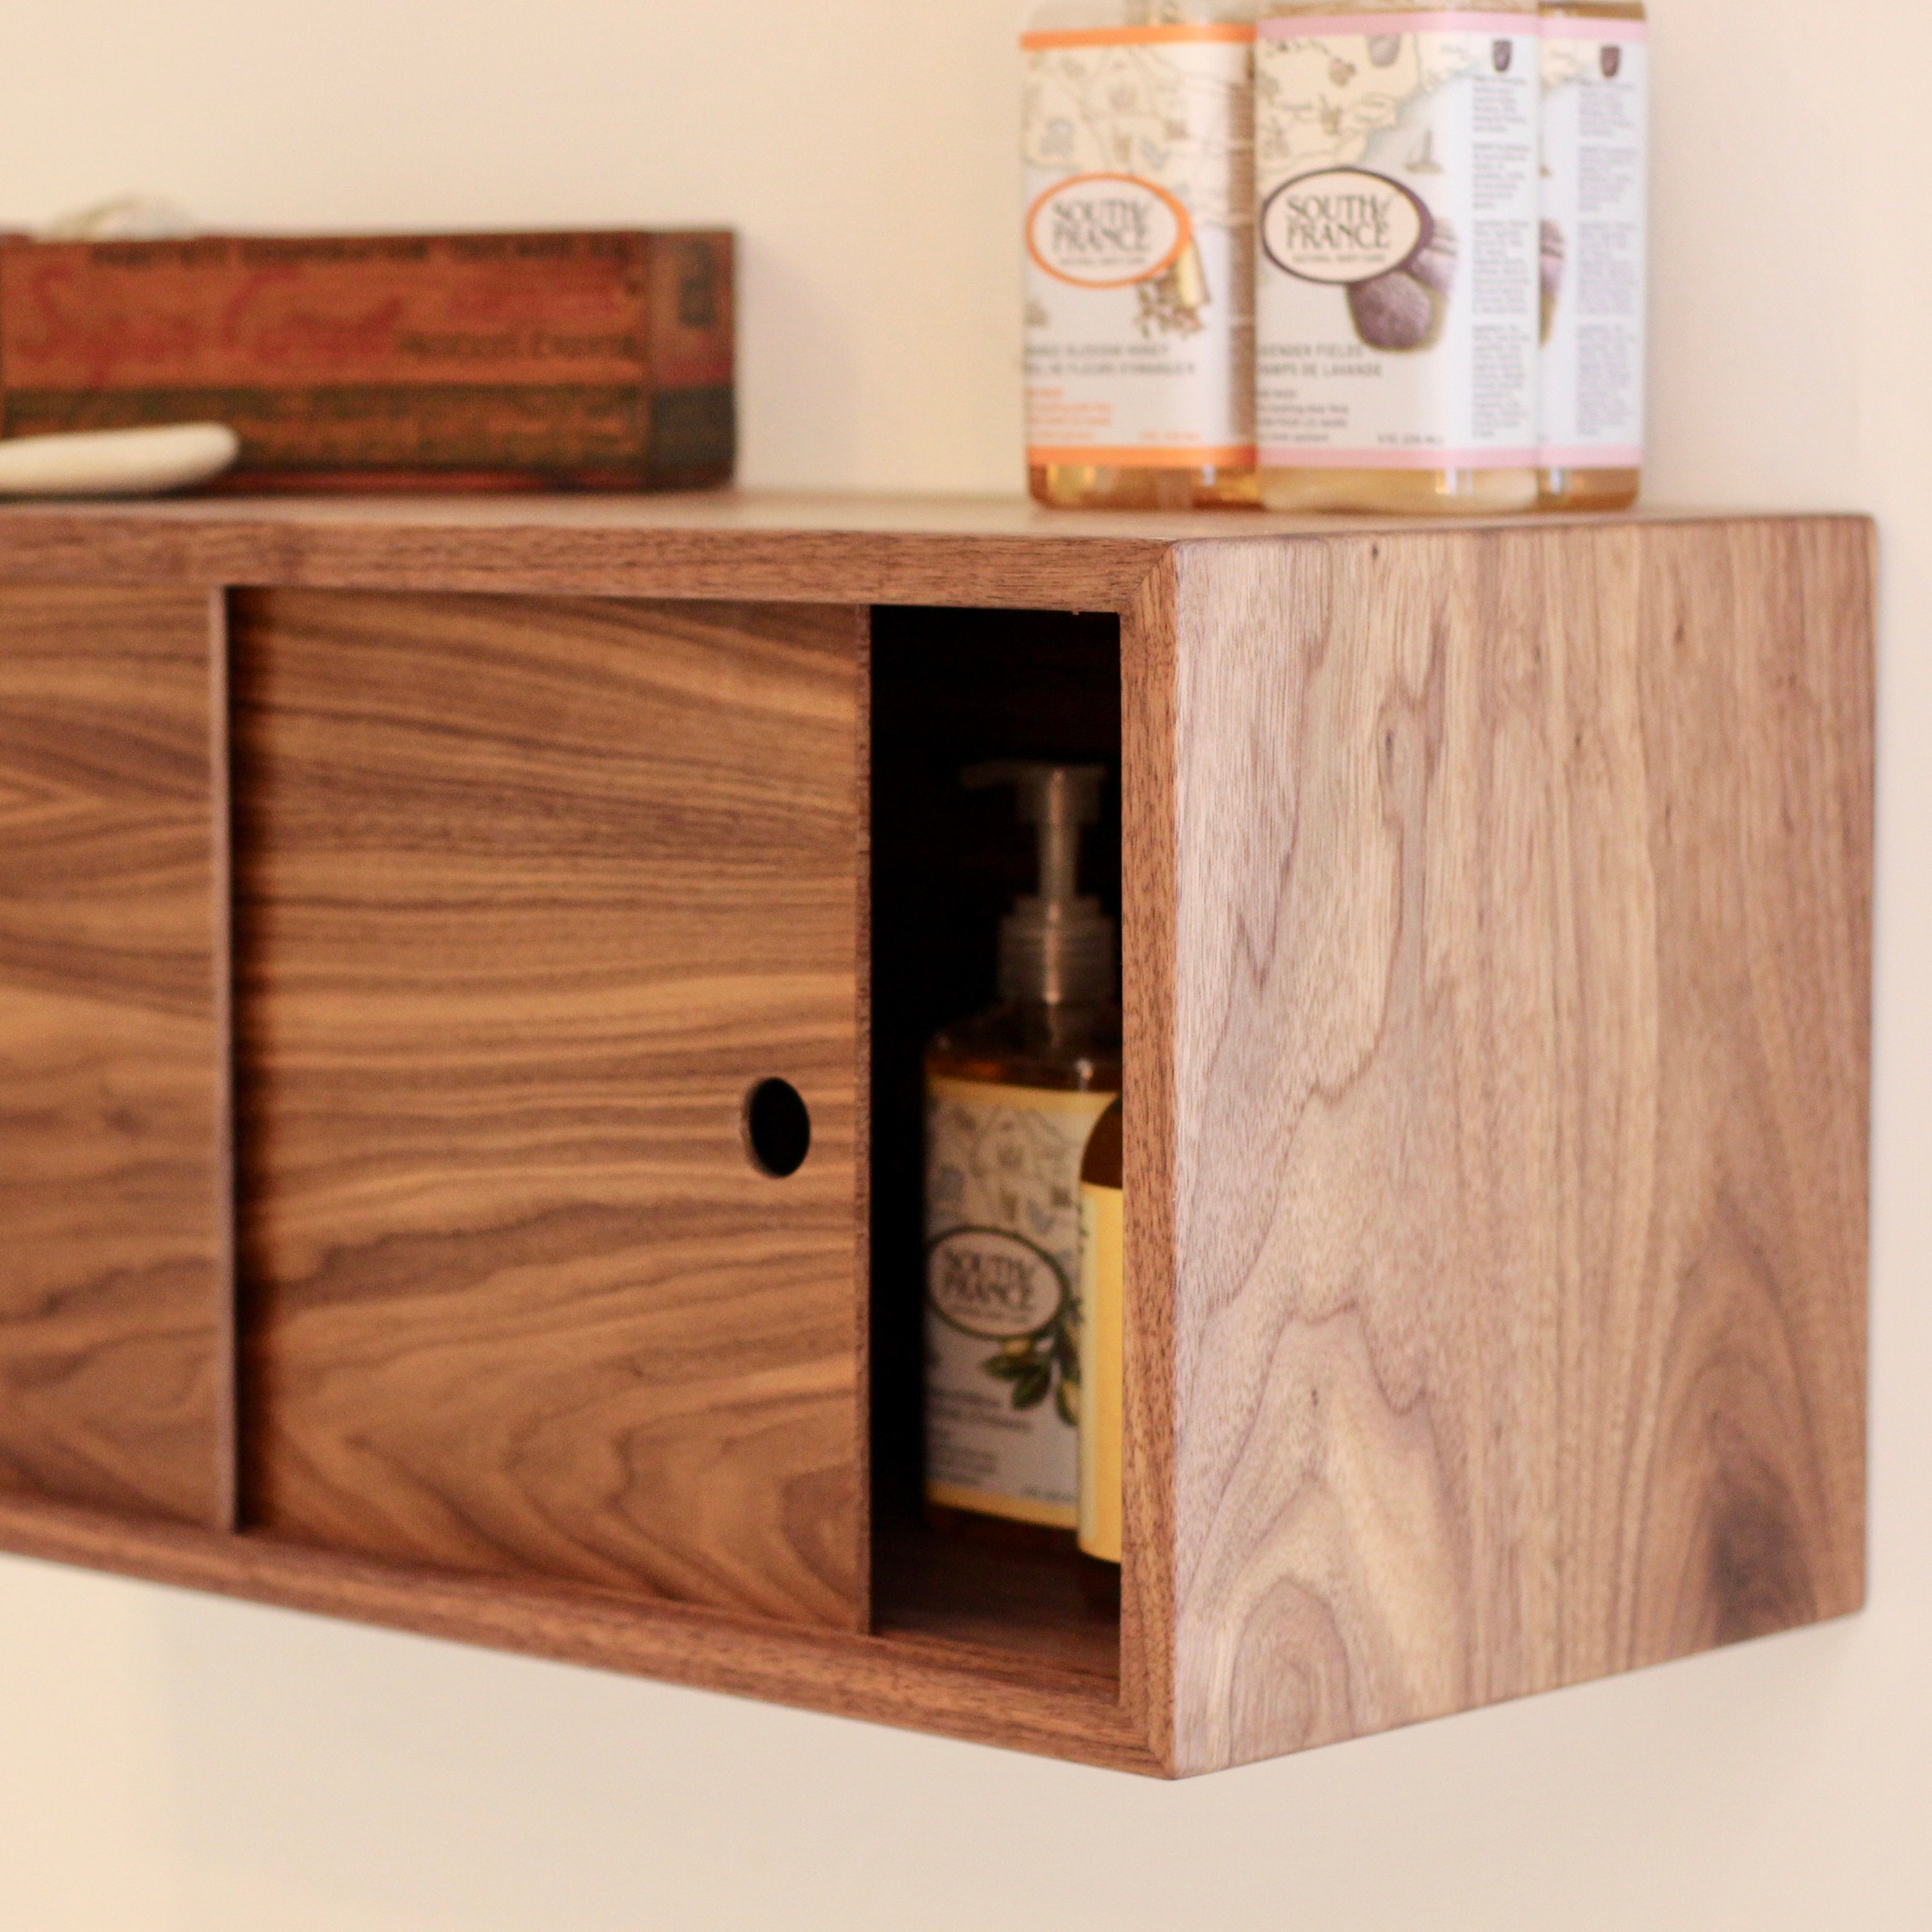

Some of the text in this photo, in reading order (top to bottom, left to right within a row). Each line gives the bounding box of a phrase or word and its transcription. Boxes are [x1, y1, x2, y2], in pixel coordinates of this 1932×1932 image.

[1053, 197, 1139, 223] SOUTH
[1286, 194, 1379, 221] SOUTH
[1052, 220, 1151, 253] FRANCE
[1286, 214, 1390, 249] FRANCE
